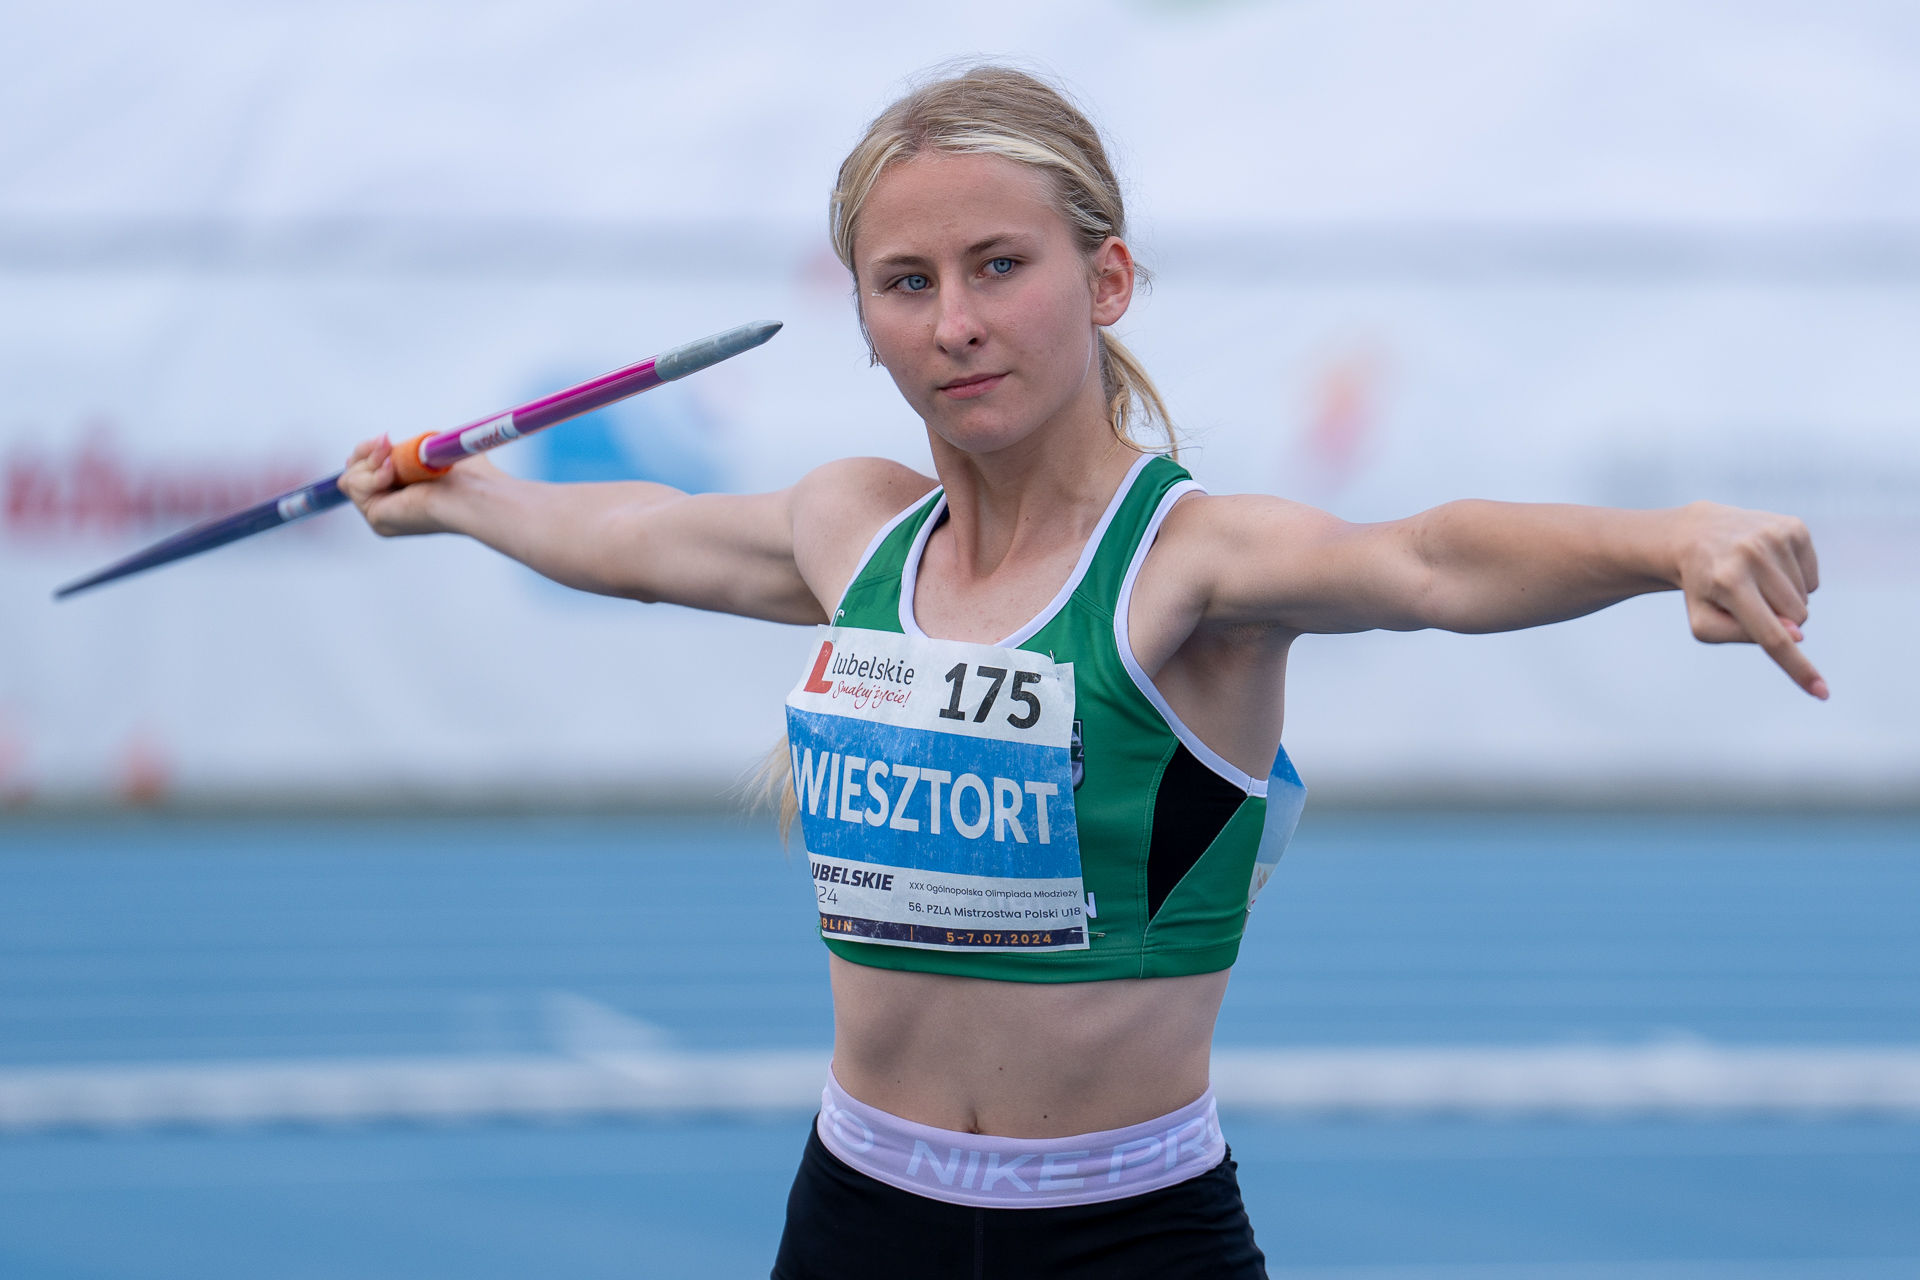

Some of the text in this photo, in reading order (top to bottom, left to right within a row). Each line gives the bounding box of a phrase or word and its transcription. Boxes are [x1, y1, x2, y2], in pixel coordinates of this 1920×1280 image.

[832, 652, 915, 685] lubelskie
[832, 680, 876, 709] Smakuj
[939, 662, 1042, 729] 175
[792, 744, 1059, 845] WIESZTORT
[909, 881, 1078, 900] XXX Ogólnopolska Olimpiada Młodzieży
[908, 902, 1081, 919] 56. PZLA Mistrzostwa Polski U18
[946, 931, 1052, 945] 5-7.07.2024
[905, 1140, 1089, 1192] NIKE
